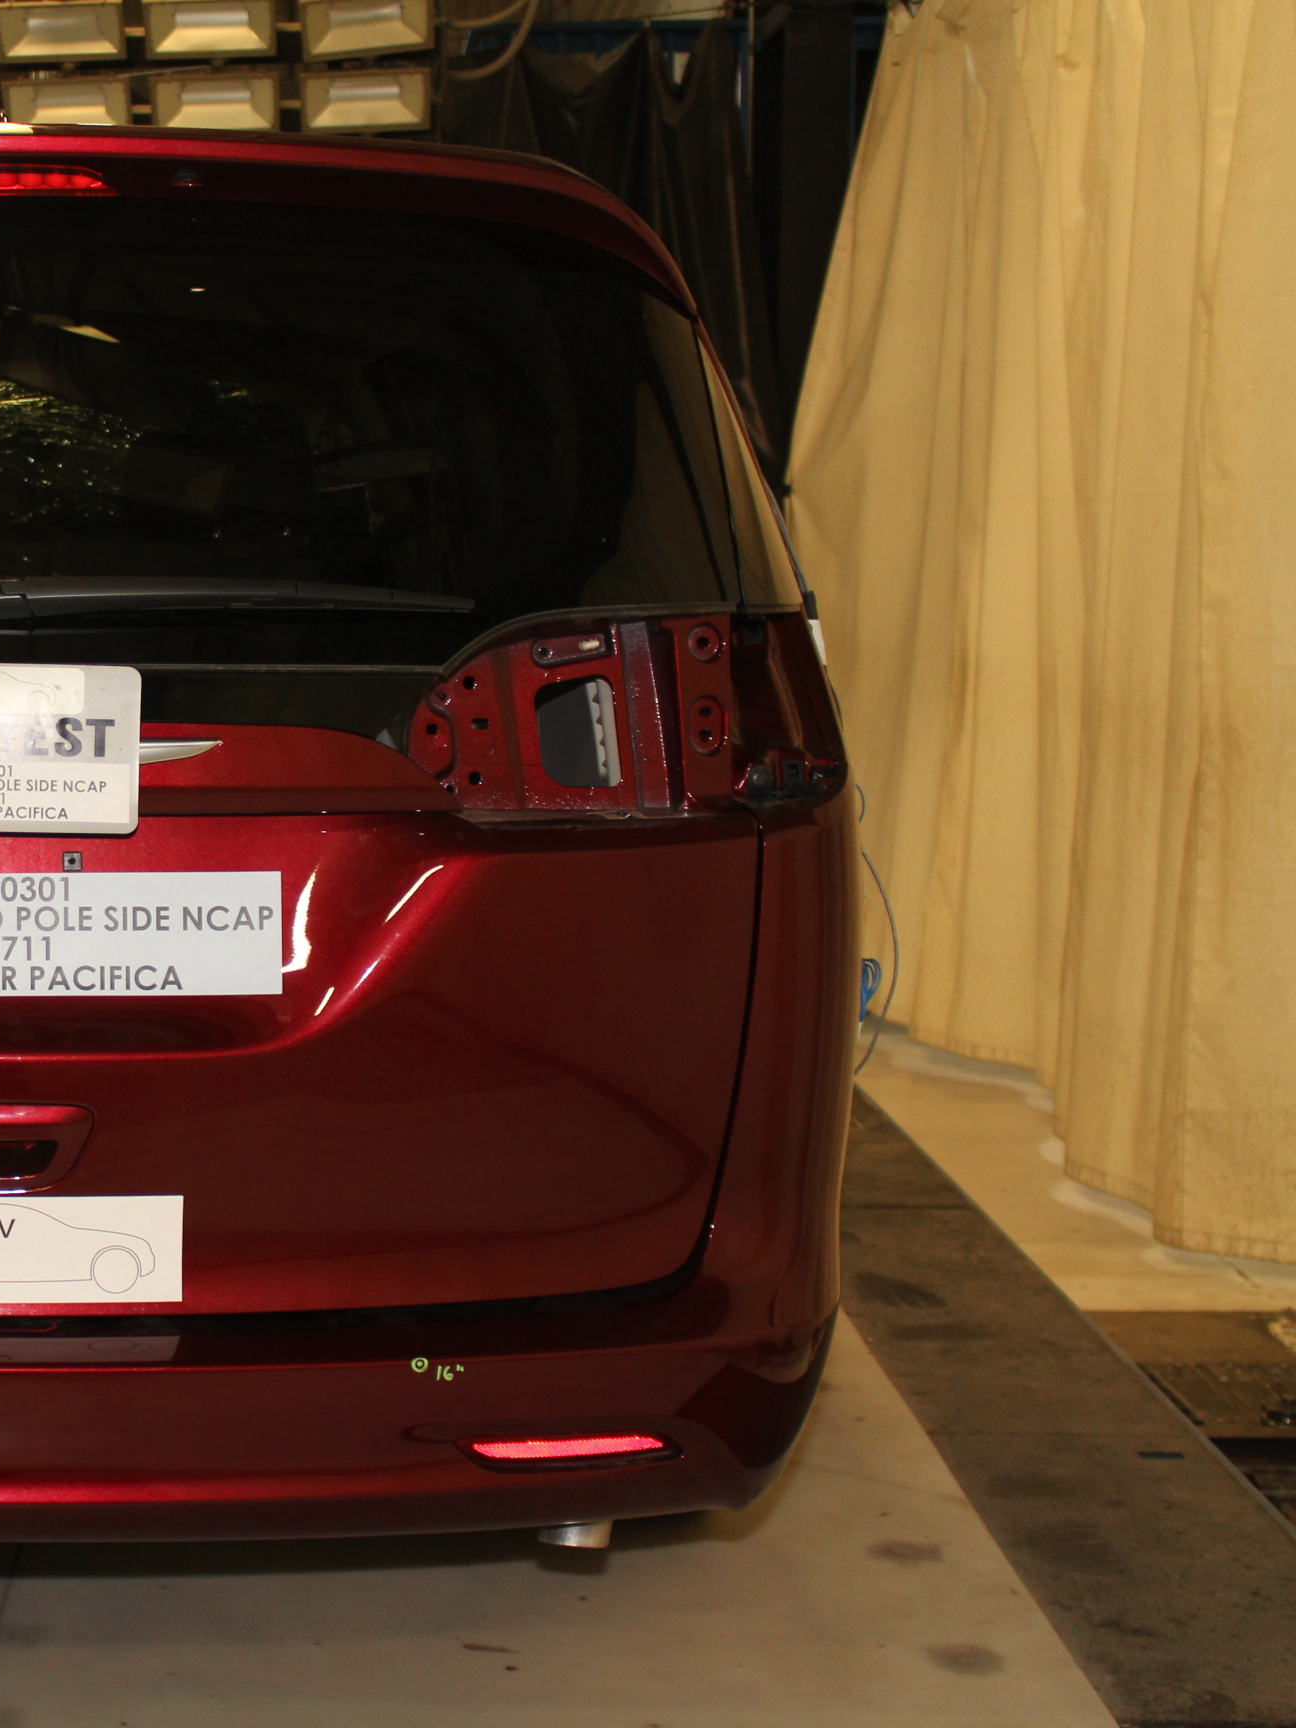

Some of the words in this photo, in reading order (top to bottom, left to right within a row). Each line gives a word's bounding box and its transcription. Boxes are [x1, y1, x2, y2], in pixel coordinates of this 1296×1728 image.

[26, 780, 58, 793] SIDE
[63, 780, 107, 794] NCAP
[16, 906, 94, 932] POLE
[104, 906, 170, 932] SIDE
[183, 906, 275, 932] NCAP
[30, 964, 184, 991] PACIFICA
